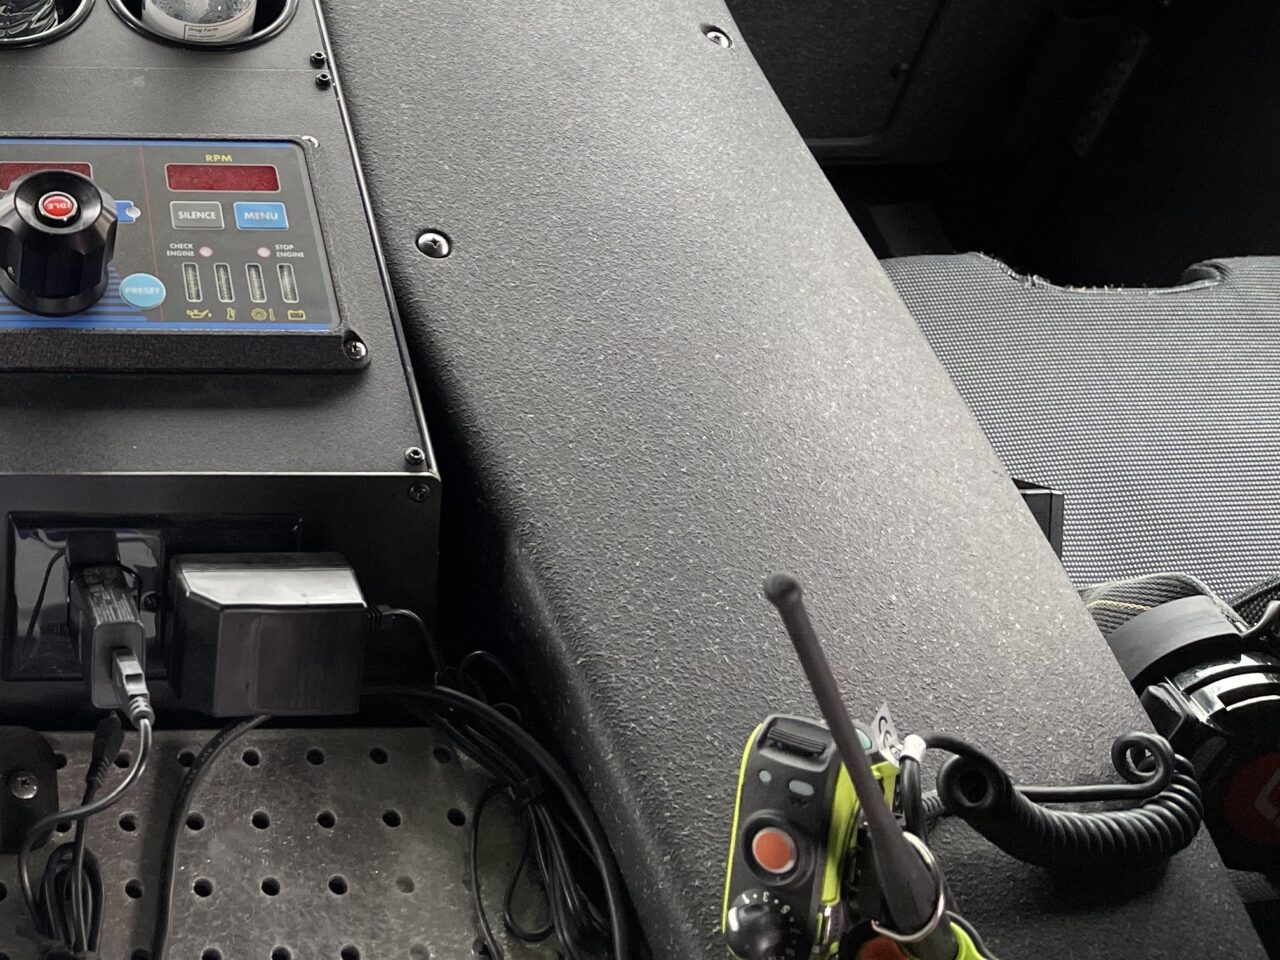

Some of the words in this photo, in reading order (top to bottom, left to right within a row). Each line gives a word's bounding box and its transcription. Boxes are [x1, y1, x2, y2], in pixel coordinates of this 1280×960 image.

[205, 154, 233, 162] RPM
[178, 210, 216, 220] SILENCE
[244, 212, 278, 220] MENU
